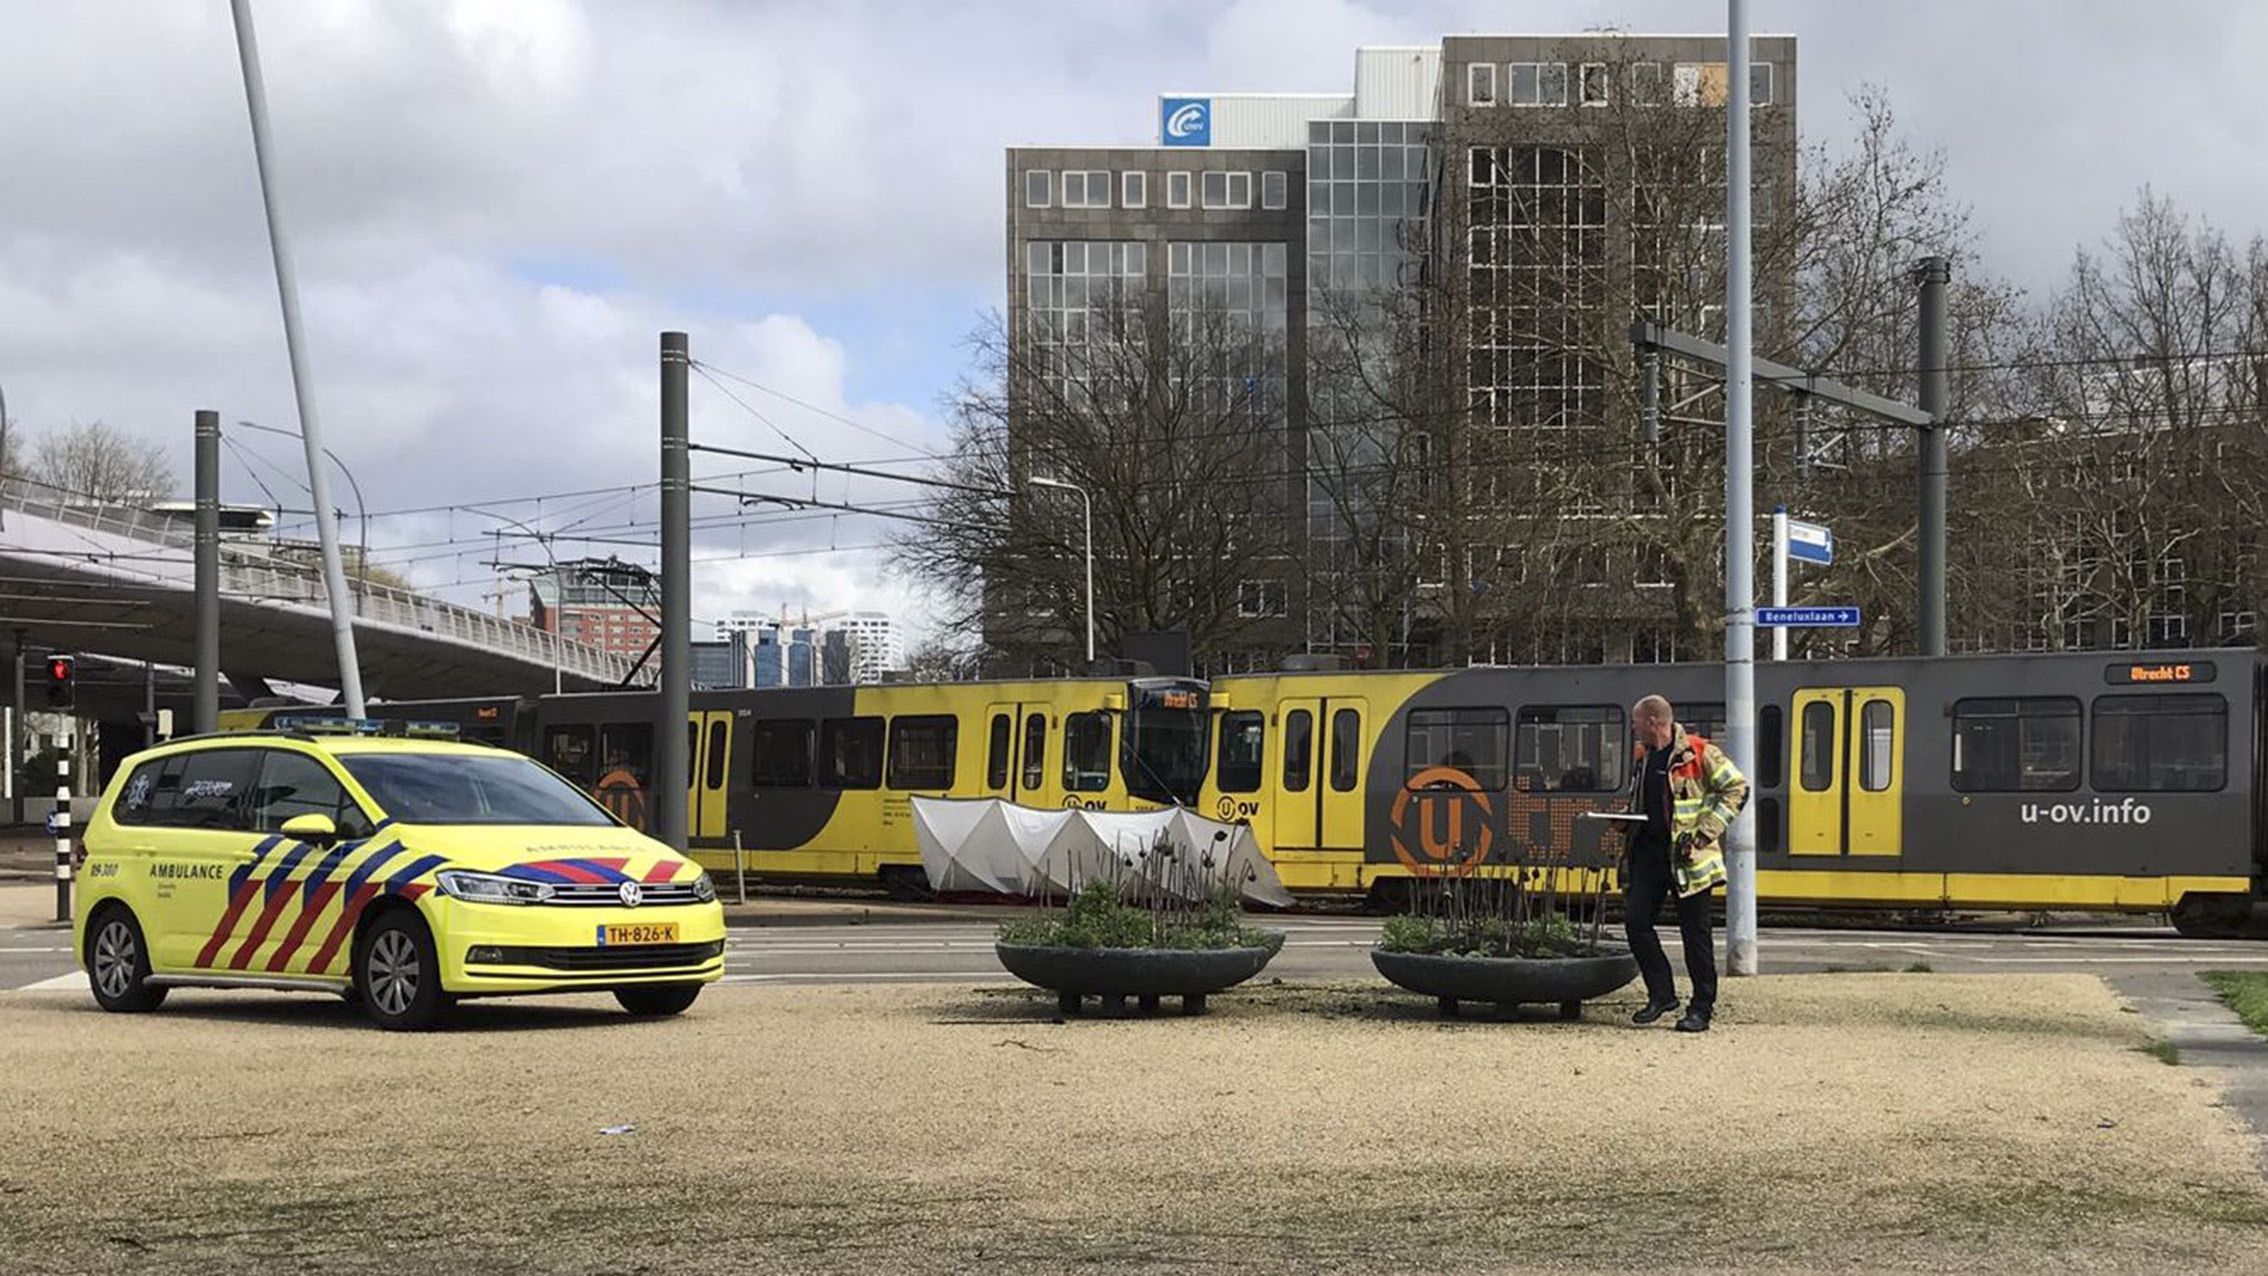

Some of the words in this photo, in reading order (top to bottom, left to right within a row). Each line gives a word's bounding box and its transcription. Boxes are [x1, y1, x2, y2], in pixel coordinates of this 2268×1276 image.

[1765, 611, 1835, 622] Beneluxlaan
[2131, 666, 2173, 680] Utrecht
[2175, 665, 2190, 679] CS
[1237, 801, 1260, 816] OV
[2020, 797, 2151, 824] u-ov.info
[149, 864, 223, 879] AMBULANCE
[608, 926, 674, 942] TH-826-K
